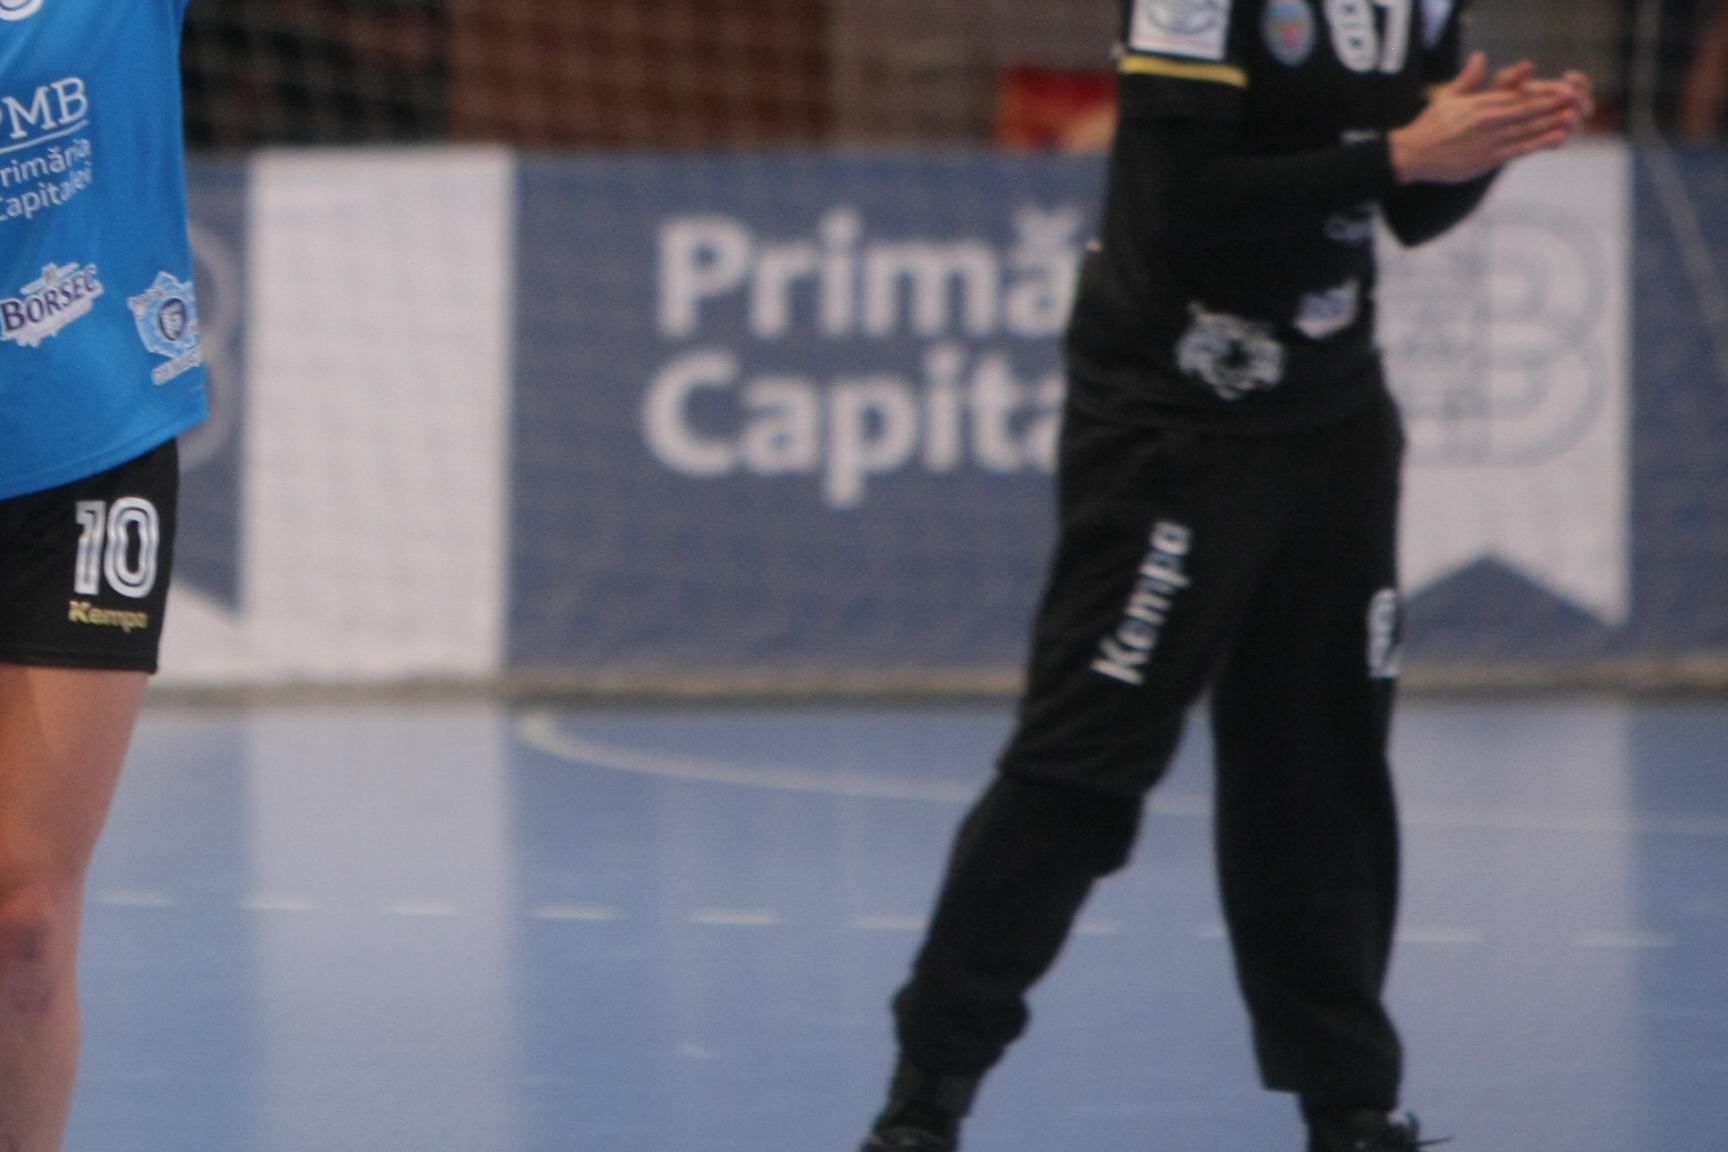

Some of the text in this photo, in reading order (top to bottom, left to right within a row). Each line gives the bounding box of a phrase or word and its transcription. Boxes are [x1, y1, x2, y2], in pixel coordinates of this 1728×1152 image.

[74, 497, 160, 598] 10
[69, 601, 148, 633] Kempa
[1091, 520, 1193, 686] Kempa
